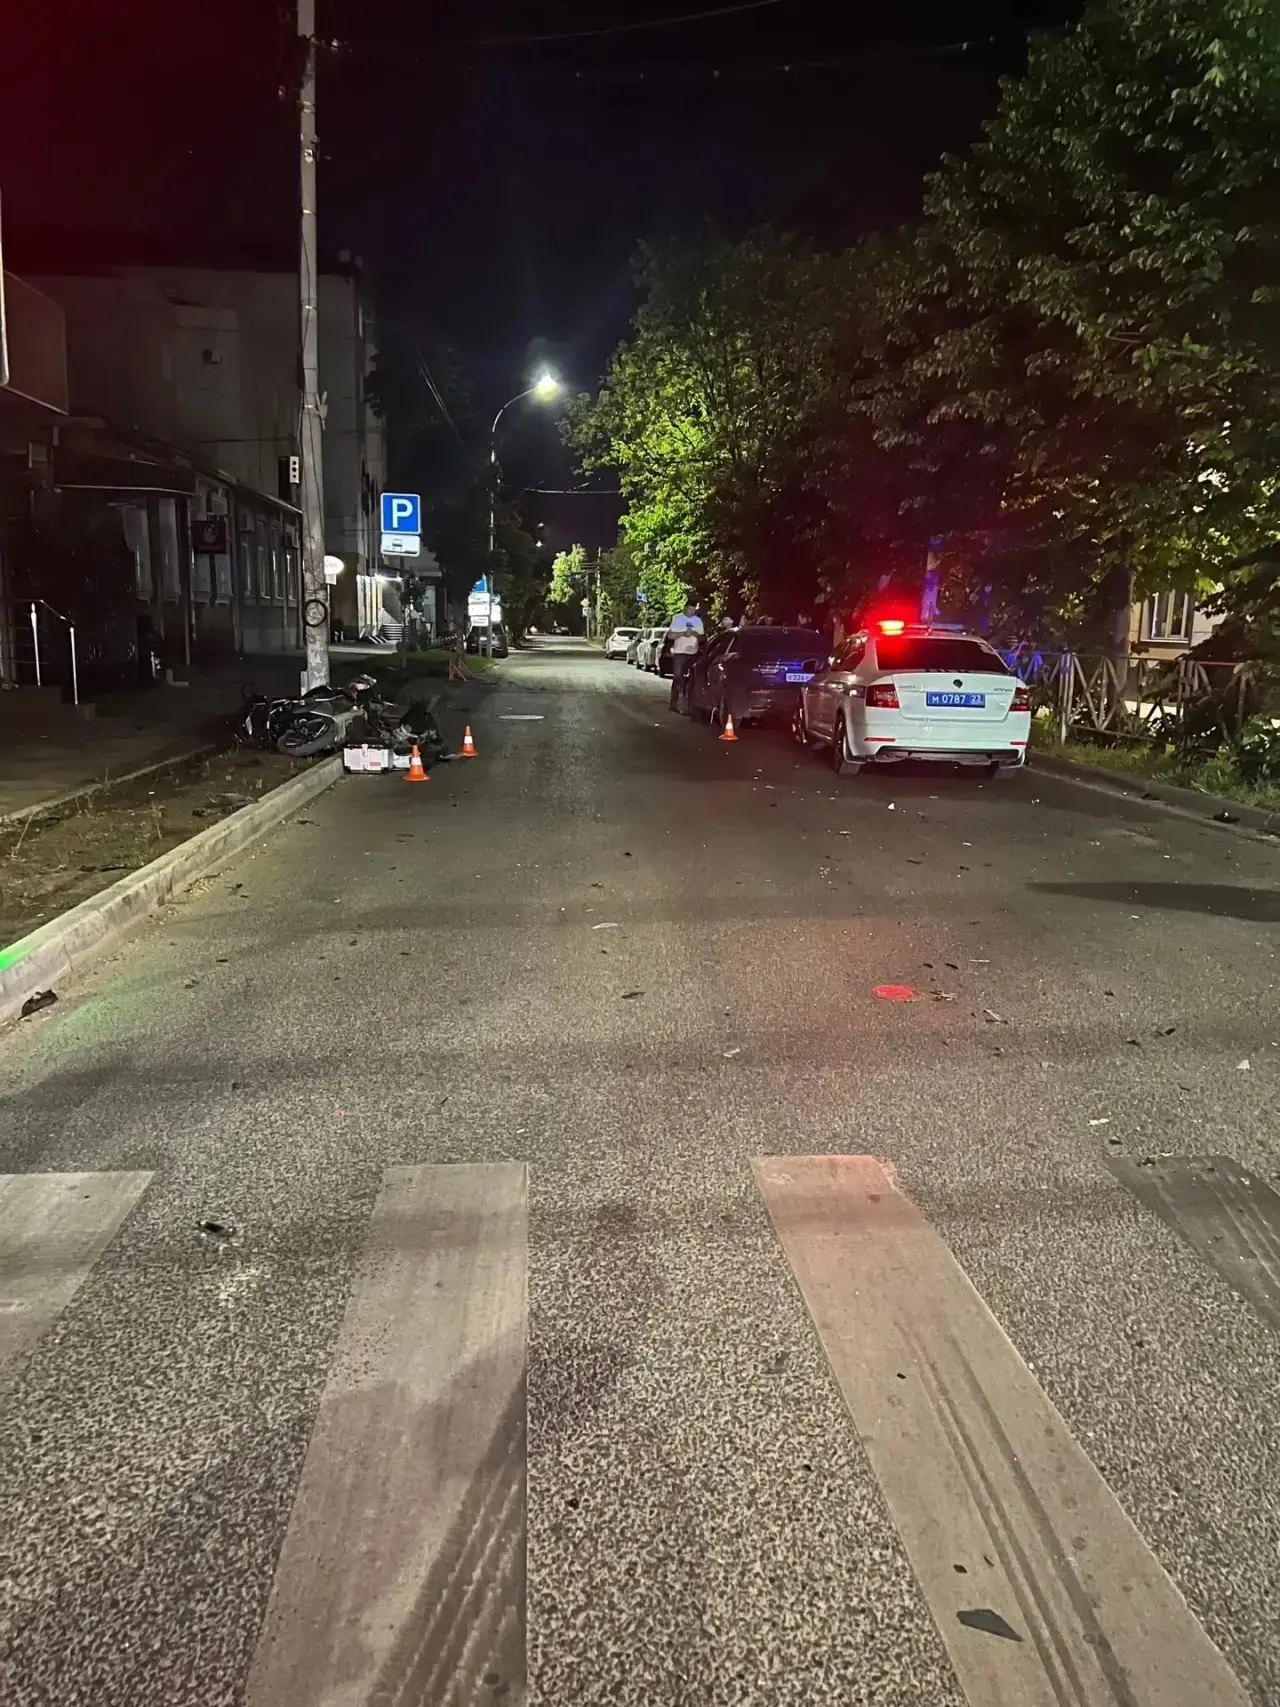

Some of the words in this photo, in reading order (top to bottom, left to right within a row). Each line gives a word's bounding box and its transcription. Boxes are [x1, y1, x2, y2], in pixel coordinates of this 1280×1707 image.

[391, 498, 413, 529] P
[942, 694, 966, 704] 0787
[971, 694, 981, 702] 23
